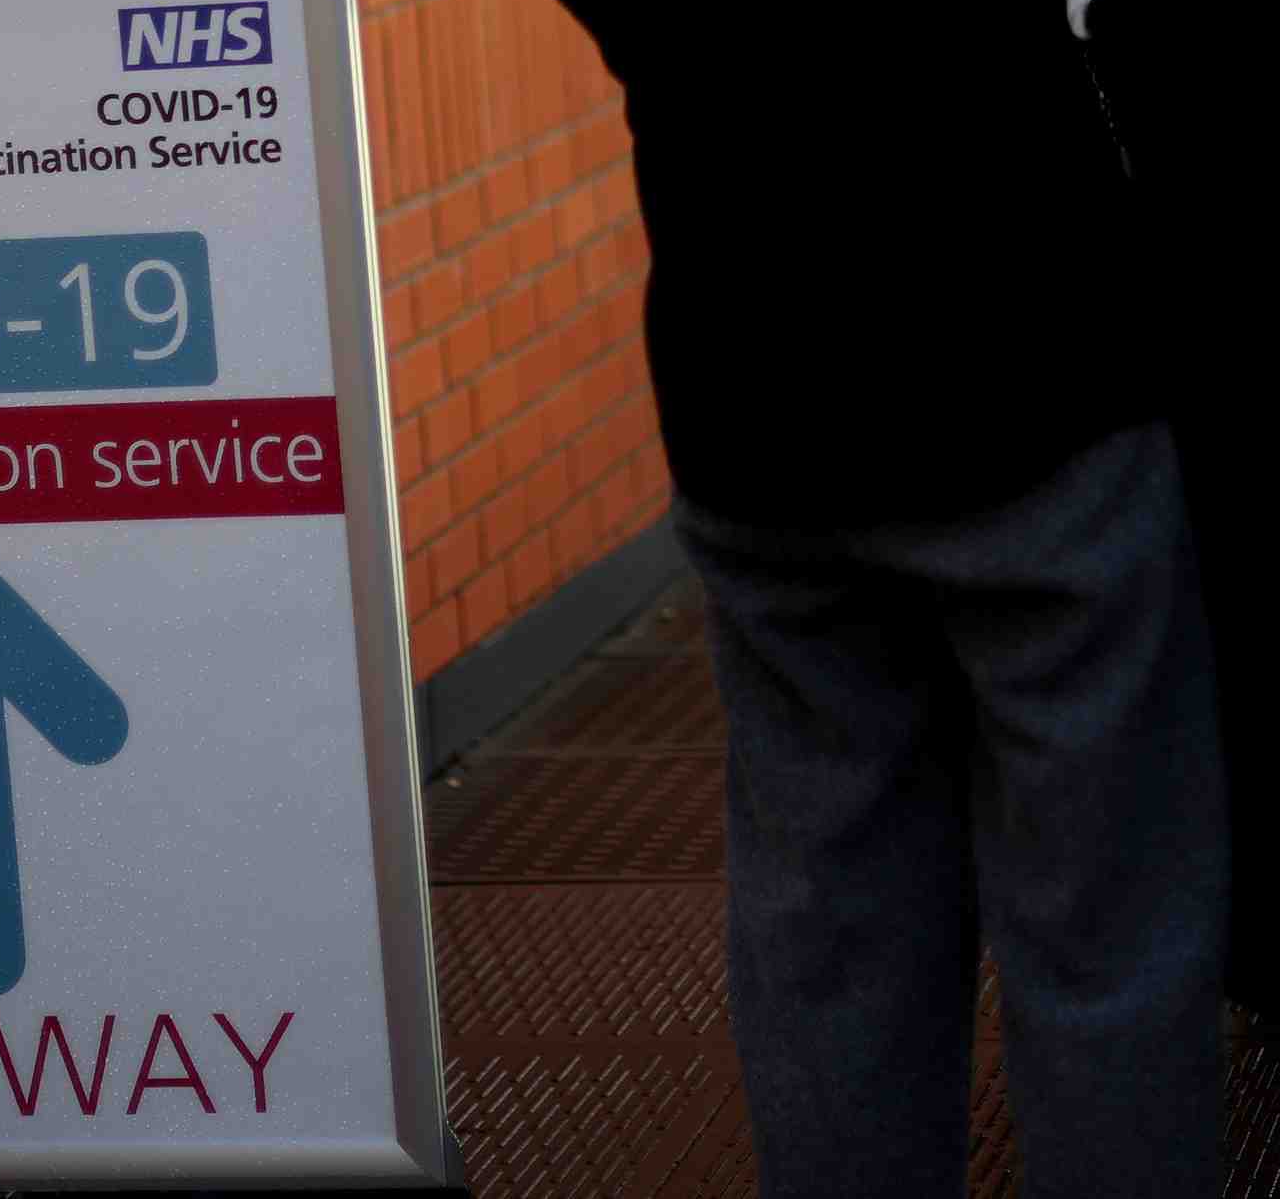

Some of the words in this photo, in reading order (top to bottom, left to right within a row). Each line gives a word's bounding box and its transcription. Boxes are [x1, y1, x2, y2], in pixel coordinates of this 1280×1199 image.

[127, 6, 265, 65] NHS
[96, 85, 278, 128] COVID-19
[150, 131, 282, 167] Service
[91, 419, 325, 488] service
